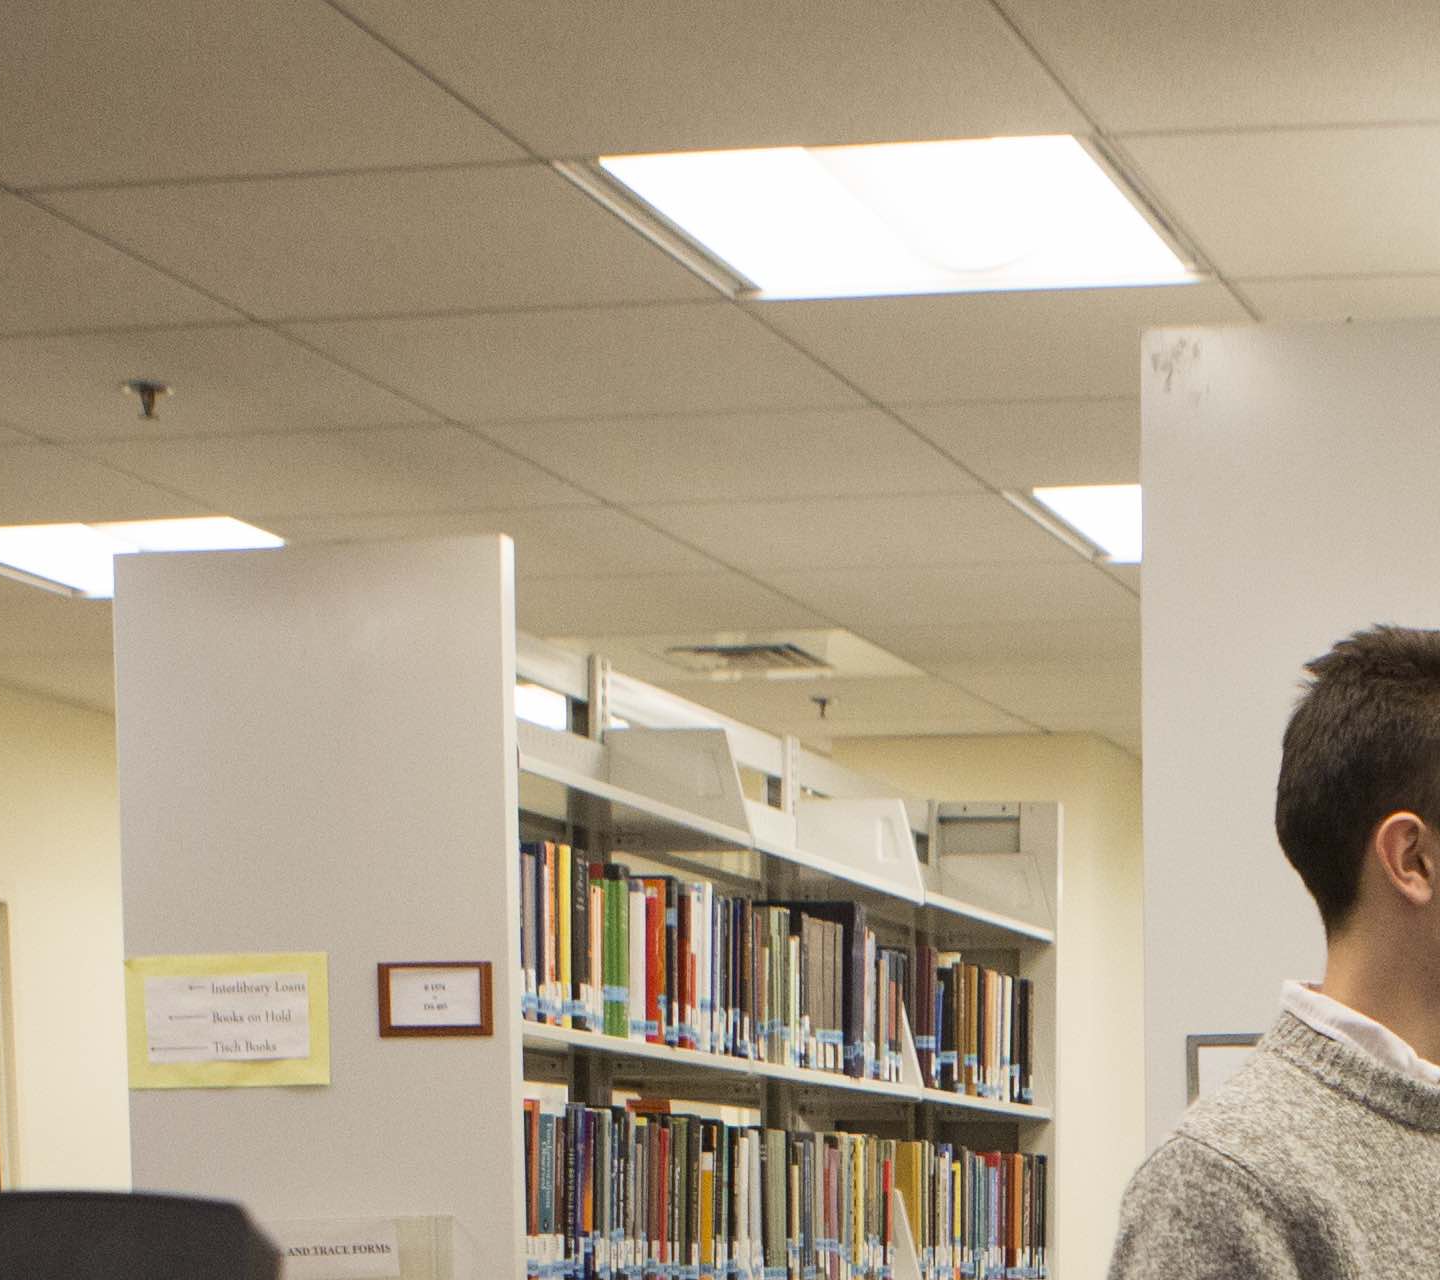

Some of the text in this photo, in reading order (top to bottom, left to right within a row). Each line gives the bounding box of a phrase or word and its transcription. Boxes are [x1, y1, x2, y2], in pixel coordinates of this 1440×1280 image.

[212, 980, 305, 995] Interlibrary Loans
[212, 1009, 292, 1024] Books on Hold
[245, 1040, 278, 1052] Books
[288, 1243, 392, 1257] AND TRACE FORMS
